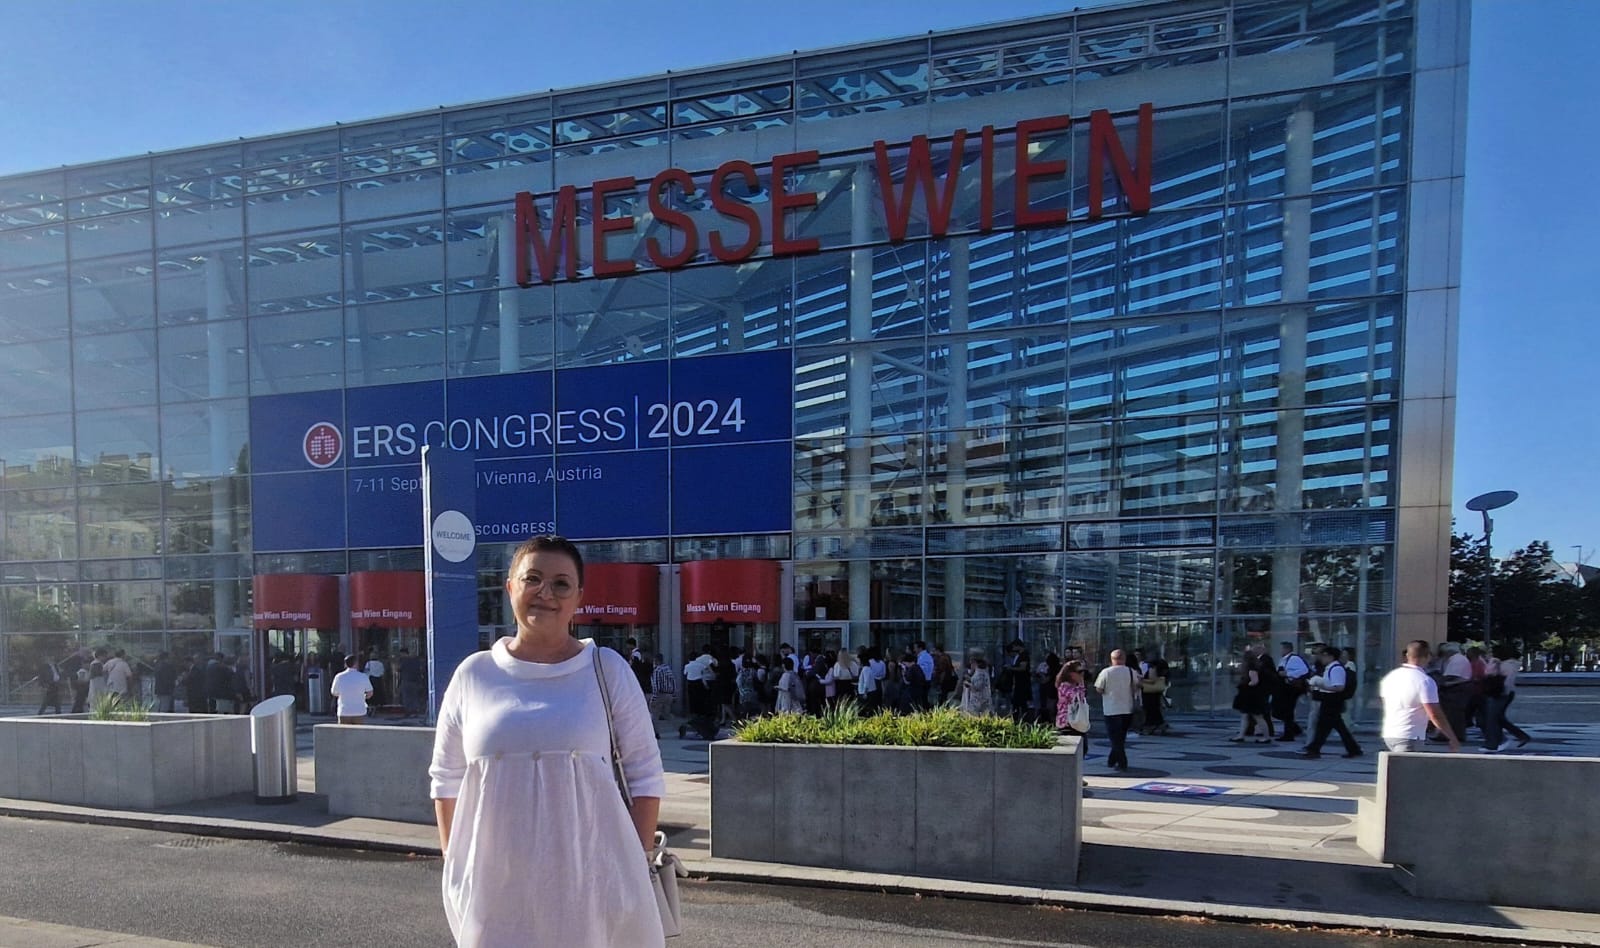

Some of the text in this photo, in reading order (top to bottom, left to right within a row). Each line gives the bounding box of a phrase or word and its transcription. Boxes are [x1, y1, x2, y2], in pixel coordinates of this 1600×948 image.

[515, 102, 1154, 287] MESSE WIEN
[353, 397, 746, 458] ERS CONGRESS 2024
[353, 478, 384, 492] 7-11
[483, 471, 541, 485] Vienna,
[545, 465, 602, 482] Austria
[436, 530, 471, 541] WELCOME
[584, 604, 605, 614] Wien
[606, 604, 637, 615] Eingang
[707, 602, 729, 611] Wien
[730, 602, 761, 613] Eingang
[281, 611, 311, 621] Eingang
[382, 608, 412, 619] Eingang
